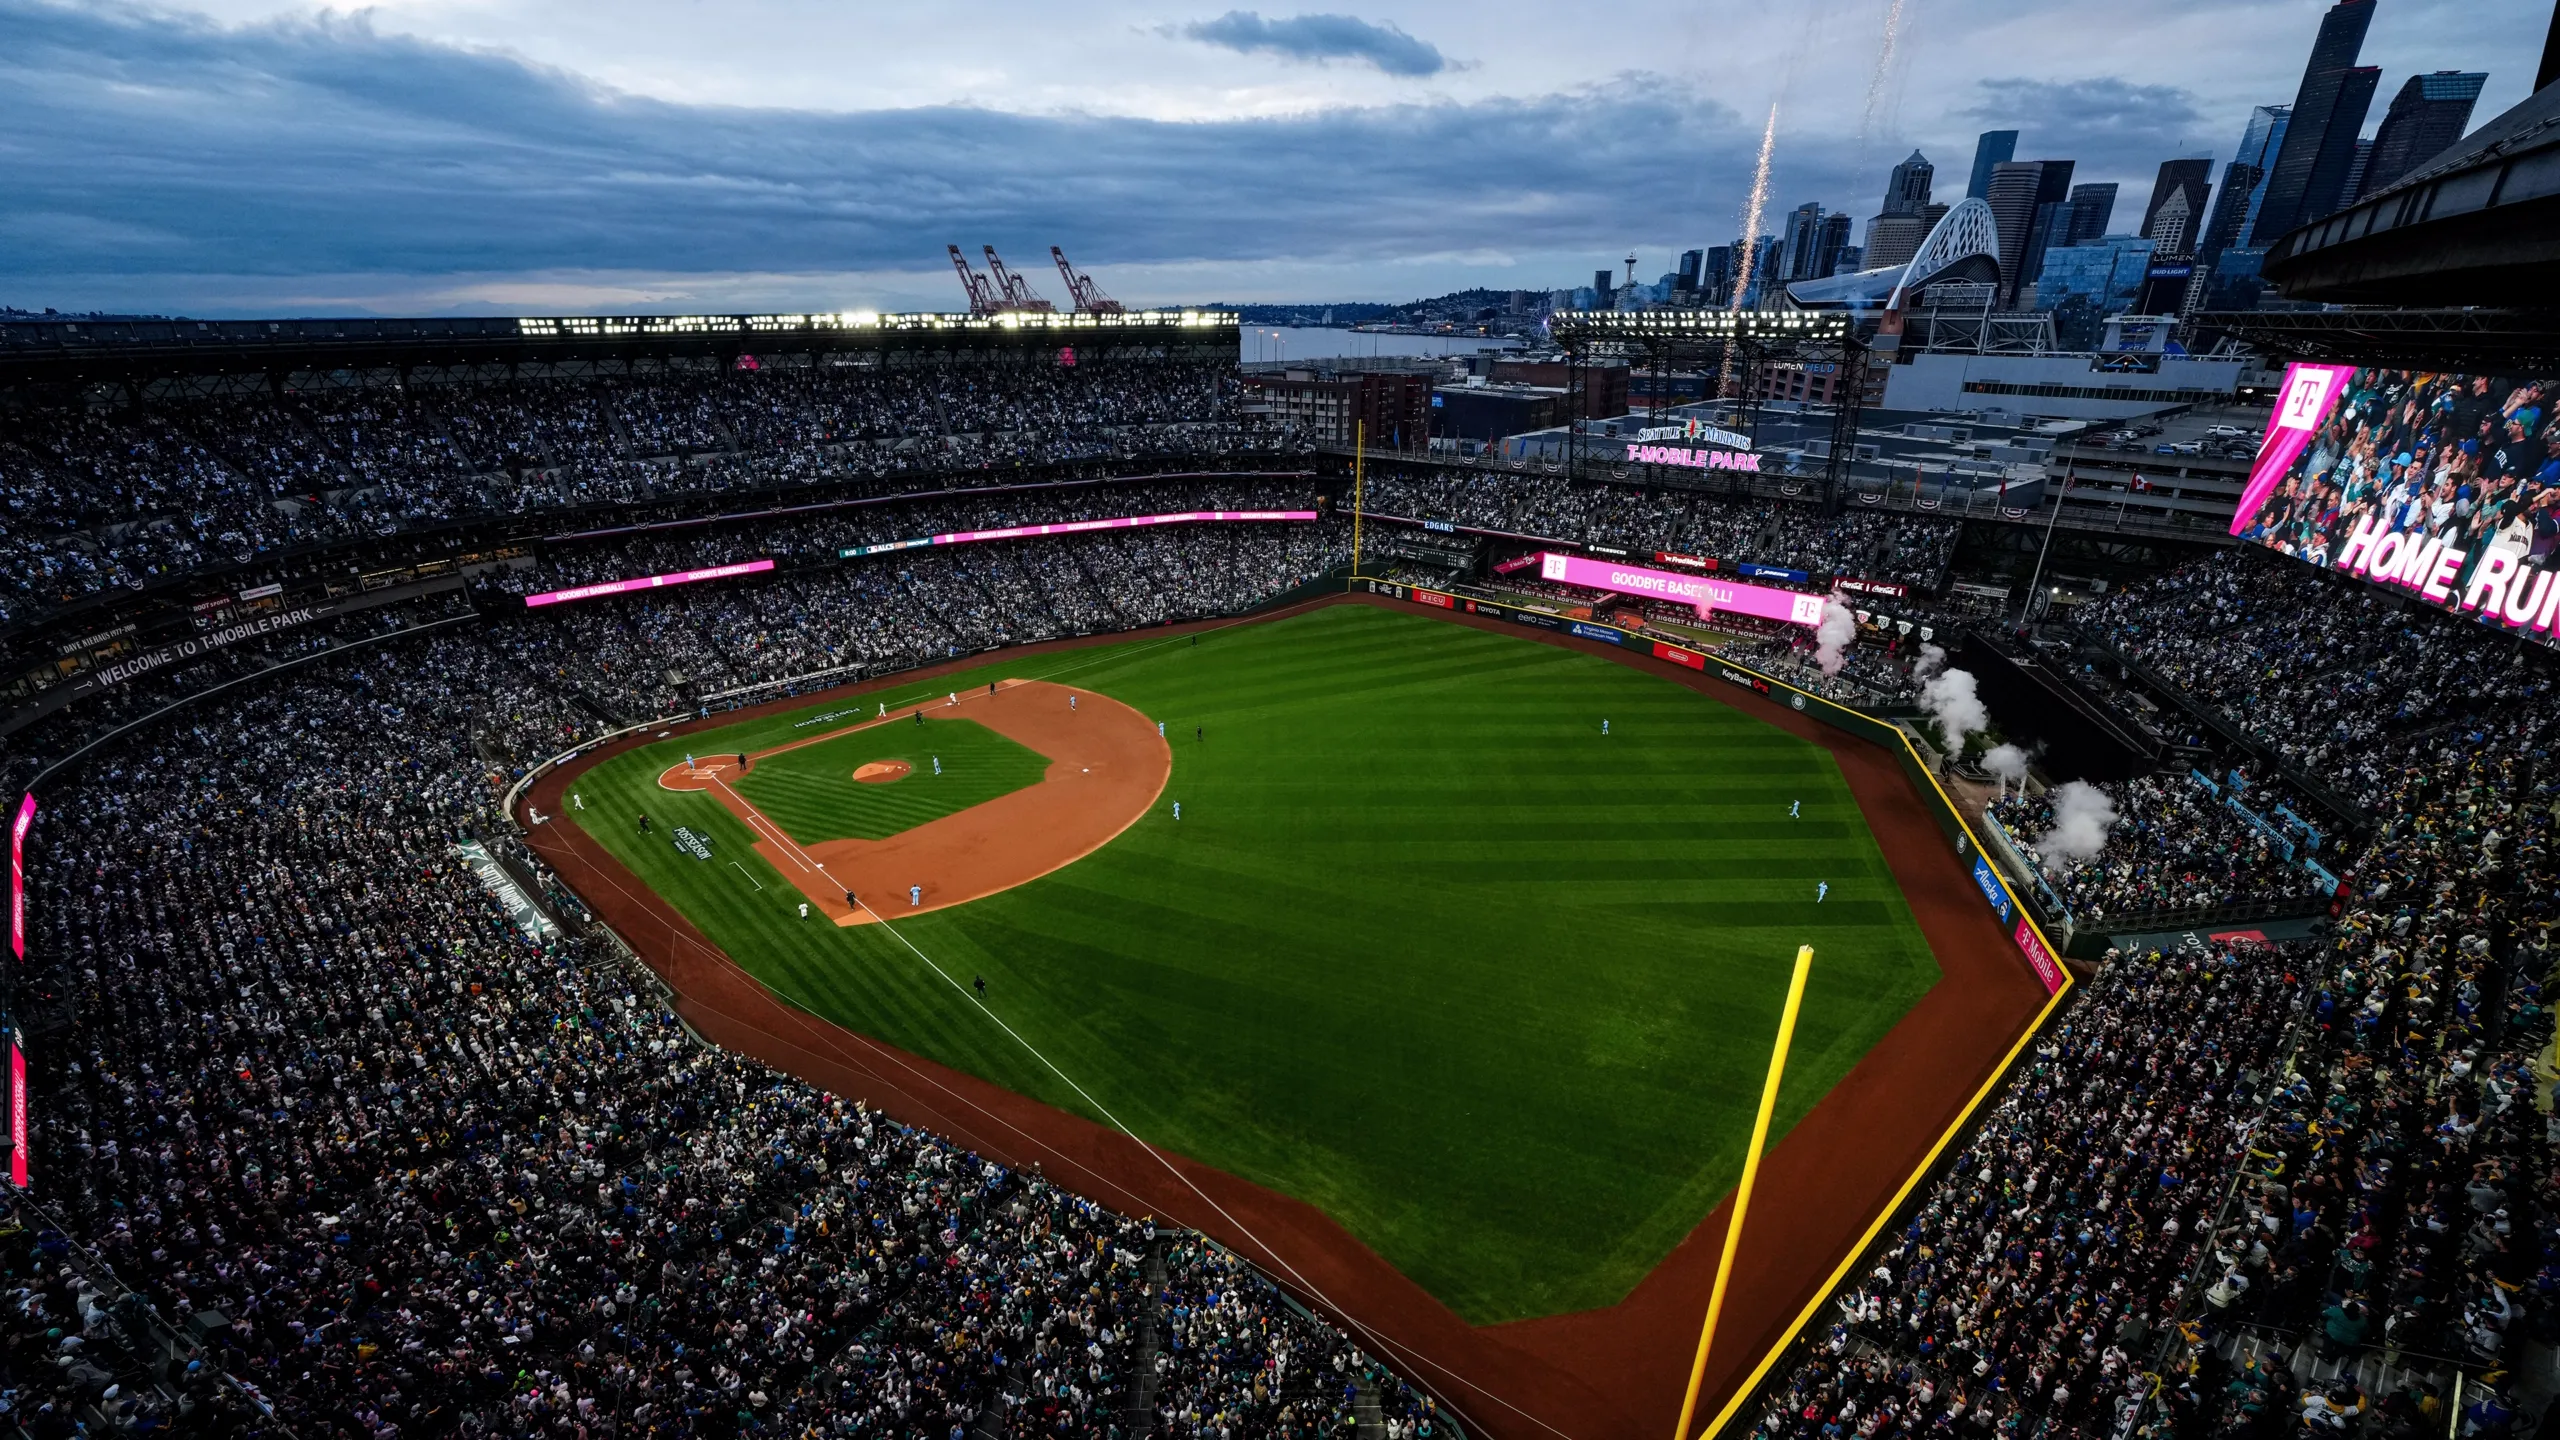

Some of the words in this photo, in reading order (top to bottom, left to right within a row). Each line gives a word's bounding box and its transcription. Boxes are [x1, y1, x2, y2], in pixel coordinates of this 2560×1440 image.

[2153, 254, 2195, 262] LUMEN
[1773, 360, 1804, 372] LUMEN
[1804, 362, 1835, 374] FIELD
[1637, 425, 1681, 442] SEATTLE
[1703, 425, 1752, 451] MARINERS
[1627, 444, 1708, 468] T-MOBILE
[1709, 450, 1763, 472] PARK
[877, 543, 895, 551] ALCS
[1596, 546, 1627, 556] STARBUCKS
[2338, 514, 2467, 603] HOME
[687, 568, 718, 580] GOODBYE
[717, 564, 750, 577] BASEBALL!
[1611, 571, 1666, 592] GOODBYE
[1763, 569, 1790, 578] BOEING
[556, 589, 589, 600] GOODBYE
[589, 583, 625, 595] BASEBALL!
[1422, 594, 1444, 604] BECU
[1491, 582, 1515, 593] BIGGEST
[1556, 596, 1594, 607] NORTHWEST
[193, 602, 209, 612] ROOT
[210, 597, 230, 607] SPORTS
[1477, 605, 1501, 615] TOYOTA
[1518, 613, 1537, 624] eero
[1656, 614, 1685, 625] BIGGEST
[1693, 621, 1712, 630] BEST
[1712, 624, 1720, 632] IN
[1722, 626, 1737, 635] THE
[1737, 630, 1776, 642] NORTHWE
[1583, 625, 1600, 633] Virginia
[1583, 630, 1606, 639] Franciscan
[1922, 631, 1930, 639] 51
[62, 640, 83, 654] DAVE
[82, 631, 112, 648] NIEHAUS
[96, 647, 172, 687] WELCOME
[174, 640, 197, 659] TO
[200, 618, 271, 650] T-MOBILE
[271, 607, 314, 632] PARK
[1669, 651, 1688, 662] Nintendo
[1721, 668, 1752, 688] KeyBank
[794, 707, 861, 728] POSTSEASON
[2235, 803, 2257, 824] J-ROD
[2259, 822, 2285, 845] SQUAD
[673, 826, 713, 860] POSTSEASON
[1976, 868, 1999, 902] Alaska
[496, 883, 530, 916] MARINERS
[2182, 931, 2206, 954] TOY
[2028, 939, 2055, 982] Mobile
